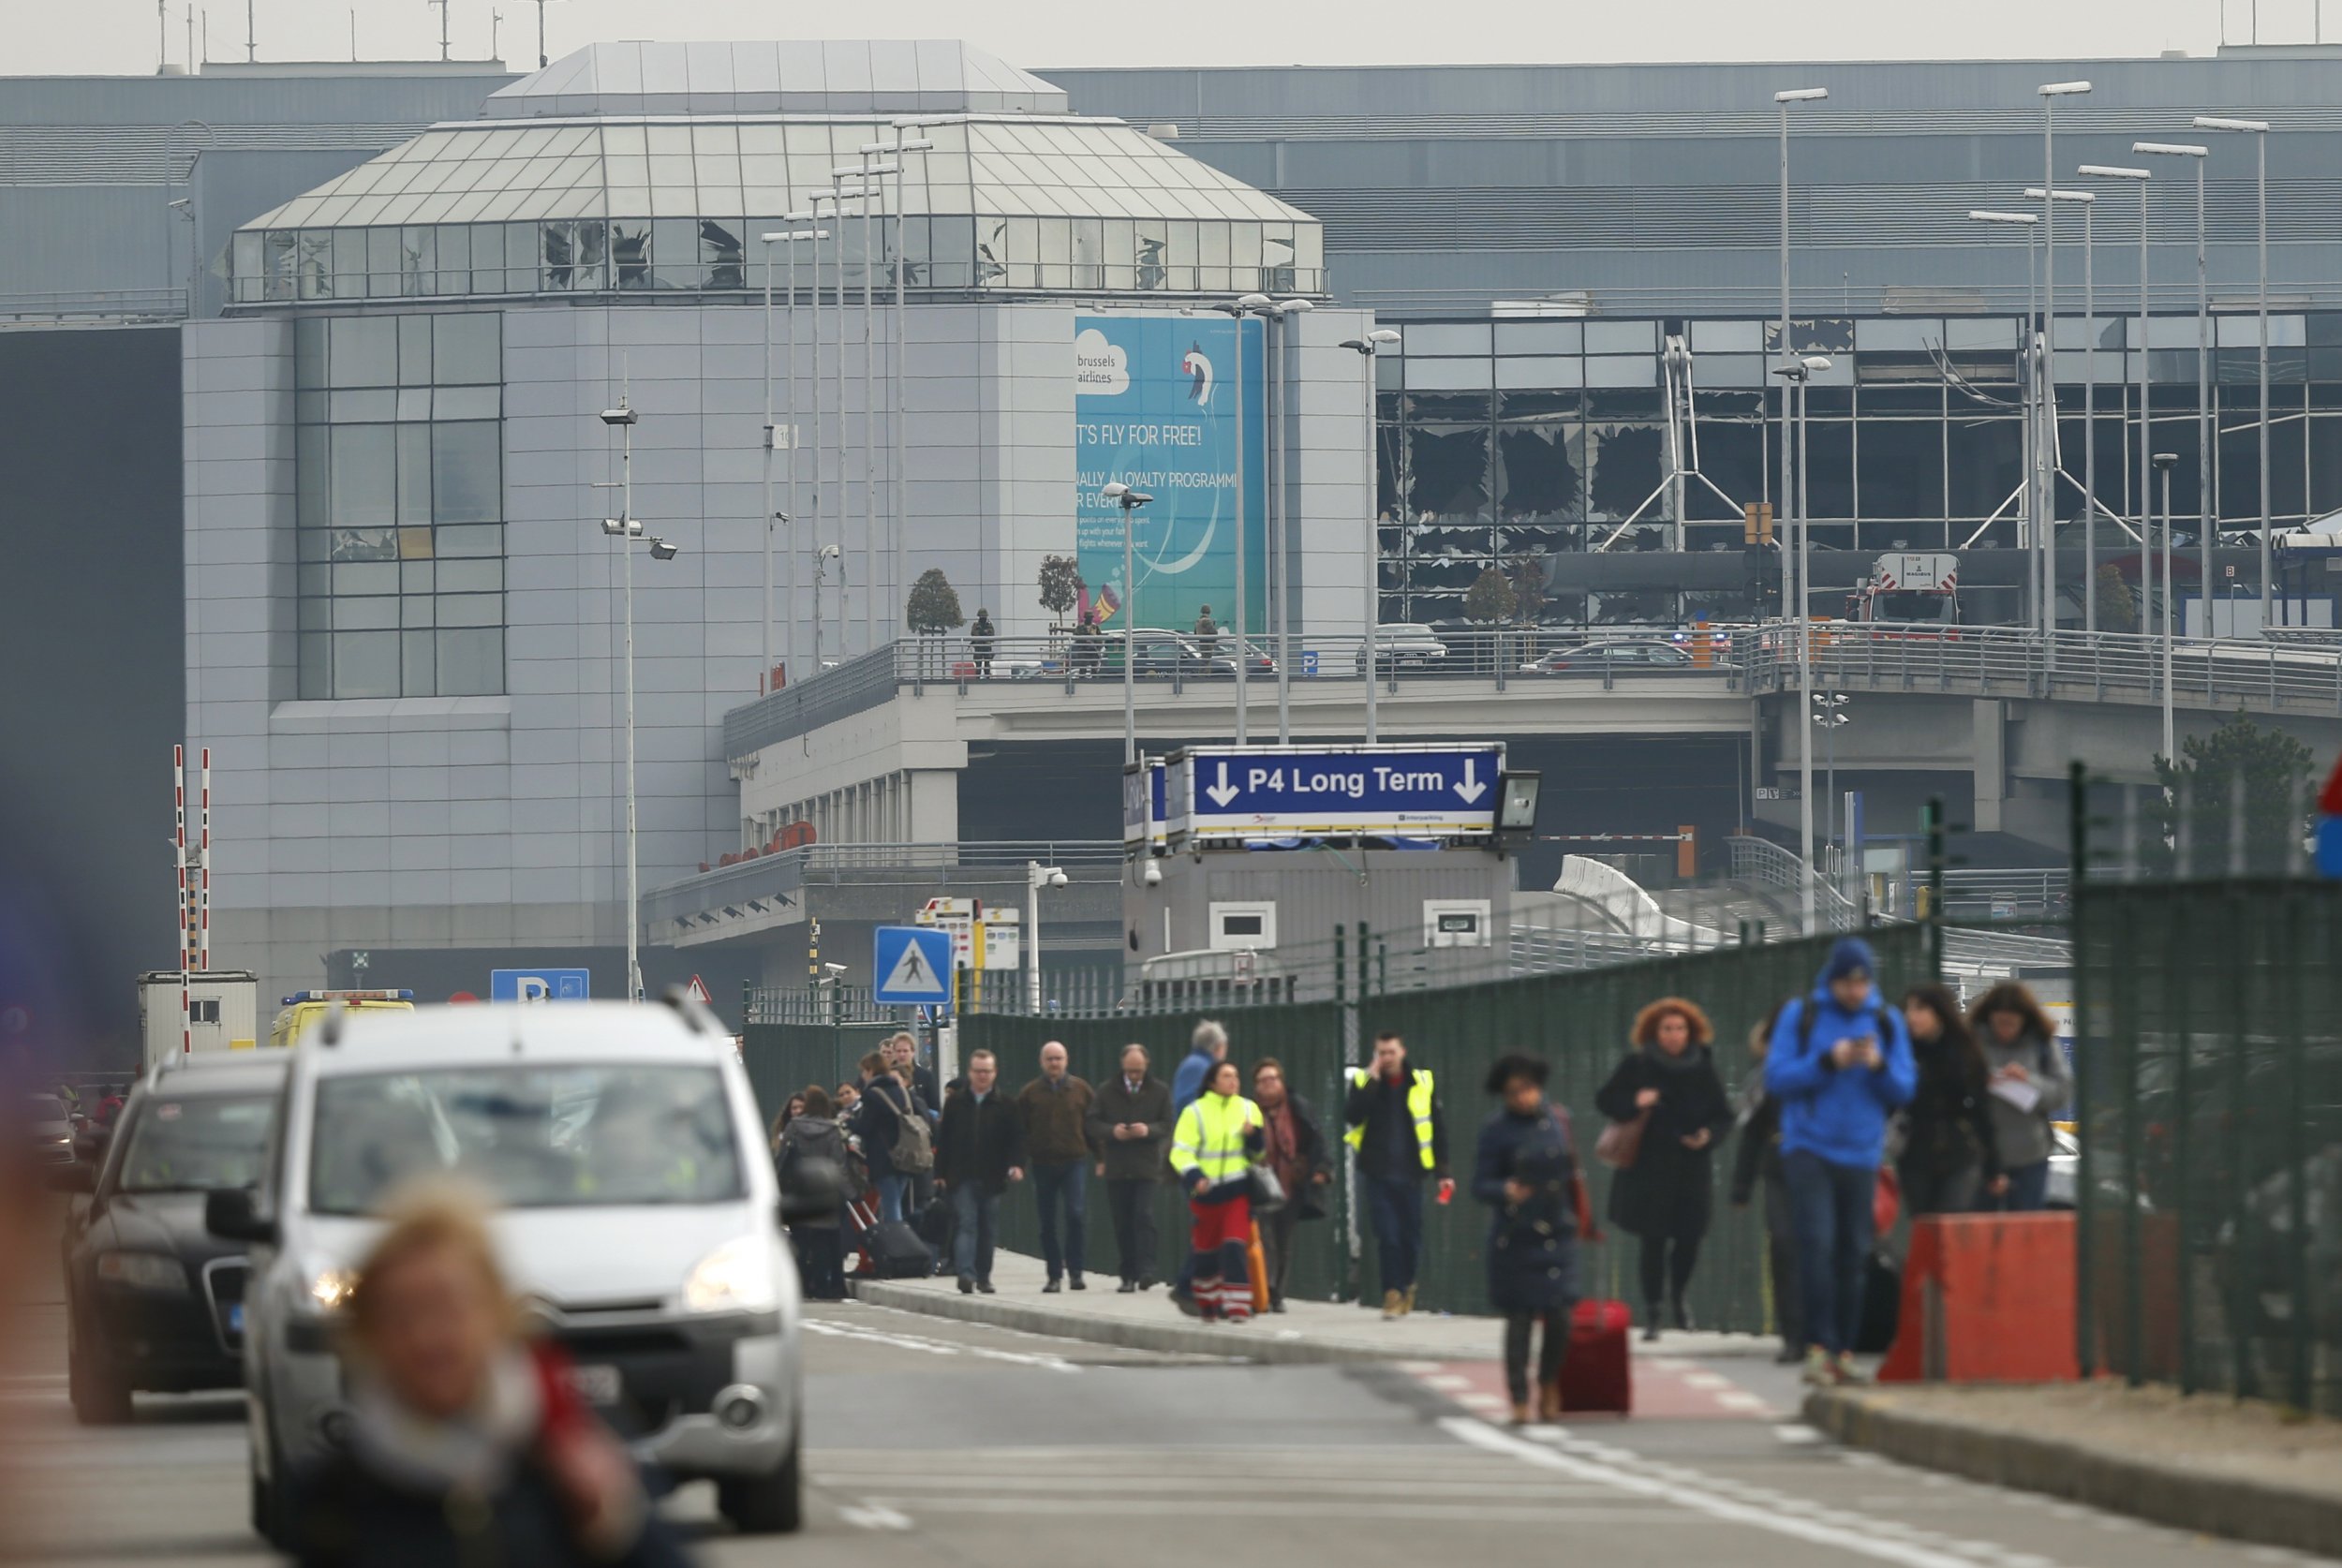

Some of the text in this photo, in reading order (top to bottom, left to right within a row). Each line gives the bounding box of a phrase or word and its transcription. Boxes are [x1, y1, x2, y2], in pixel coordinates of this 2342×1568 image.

[1077, 354, 1116, 367] brussels
[1077, 370, 1112, 383] airlines
[1102, 424, 1125, 445] FLY
[1129, 424, 1159, 445] FOR
[2227, 567, 2233, 576] B
[1303, 656, 1316, 673] P
[1248, 766, 1444, 798] P4 Long Term
[516, 976, 551, 1004] P
